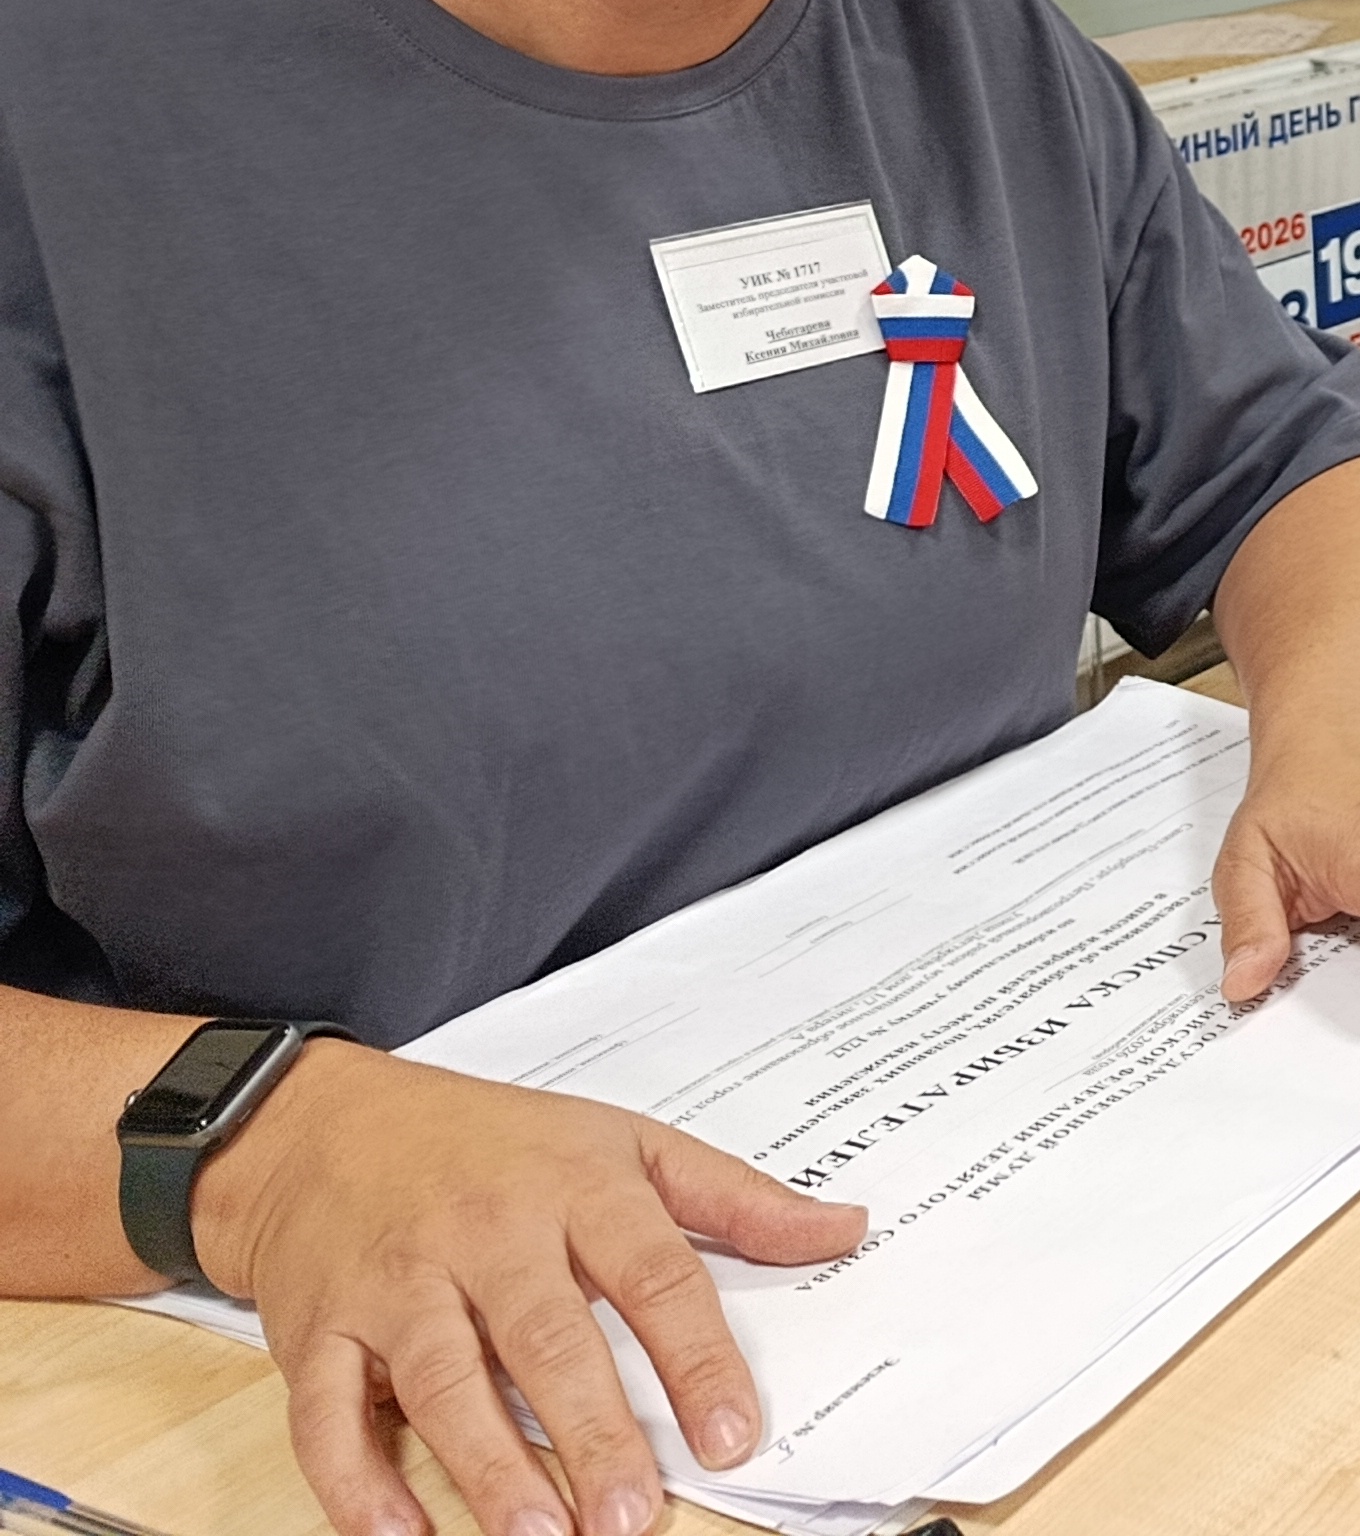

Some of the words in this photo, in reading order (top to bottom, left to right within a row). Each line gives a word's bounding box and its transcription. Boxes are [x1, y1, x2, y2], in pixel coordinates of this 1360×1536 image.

[1179, 110, 1260, 164] ИНЫЙ
[1269, 101, 1342, 149] ДЕНЬ
[1241, 213, 1306, 254] 2026
[739, 271, 773, 290] УИК
[776, 268, 791, 282] №
[793, 261, 822, 278] 1717
[697, 293, 757, 313] Заместитель
[732, 297, 802, 320] избирательной
[802, 288, 846, 304] комиссии
[1281, 289, 1312, 328] 8
[744, 344, 789, 364] Ксения
[788, 327, 860, 353] Михайловна
[1153, 892, 1168, 900] в
[1056, 918, 1076, 929] по
[1099, 901, 1155, 936] список
[1099, 896, 1191, 952] сведениями
[946, 928, 1057, 992] избирательному
[996, 935, 1100, 995] избирателей
[1078, 952, 1100, 964] об
[1274, 920, 1350, 972] СОБРАН
[883, 972, 913, 992] дом
[1064, 931, 1208, 1009] СПИСКА
[1203, 981, 1222, 997] 20
[1226, 953, 1329, 1024] ДЕПУТАТОВ
[805, 1000, 855, 1033] литера
[887, 992, 947, 1027] участку
[964, 963, 1078, 1032] избирателях,
[973, 996, 998, 1011] по
[1144, 990, 1208, 1037] сентября
[789, 1032, 806, 1040] А
[866, 1025, 888, 1037] №
[920, 1013, 974, 1040] месту
[1134, 998, 1228, 1069] СИЙСКОЙ
[742, 1029, 836, 1082] образование
[833, 1035, 870, 1061] 1717
[873, 1033, 968, 1084] подавших
[1112, 1031, 1153, 1062] 2026
[804, 1041, 920, 1107] нахождения
[1036, 1023, 1229, 1150] ГОСУДАРСТВЕННОЙ
[1081, 1053, 1118, 1081] года
[692, 1081, 743, 1110] город
[787, 1017, 1070, 1189] ИЗБИРАТЕЛЕЙ
[1013, 1067, 1135, 1142] ФЕДЕРАЦИИ
[769, 1087, 871, 1150] заявления
[753, 1151, 768, 1161] о
[898, 1142, 1013, 1225] ДЕВЯТОГО
[967, 1151, 1034, 1201] ДУМЫ
[794, 1228, 896, 1293] СОЗЫВА
[813, 1358, 900, 1421] Экземпляр
[792, 1421, 815, 1437] №
